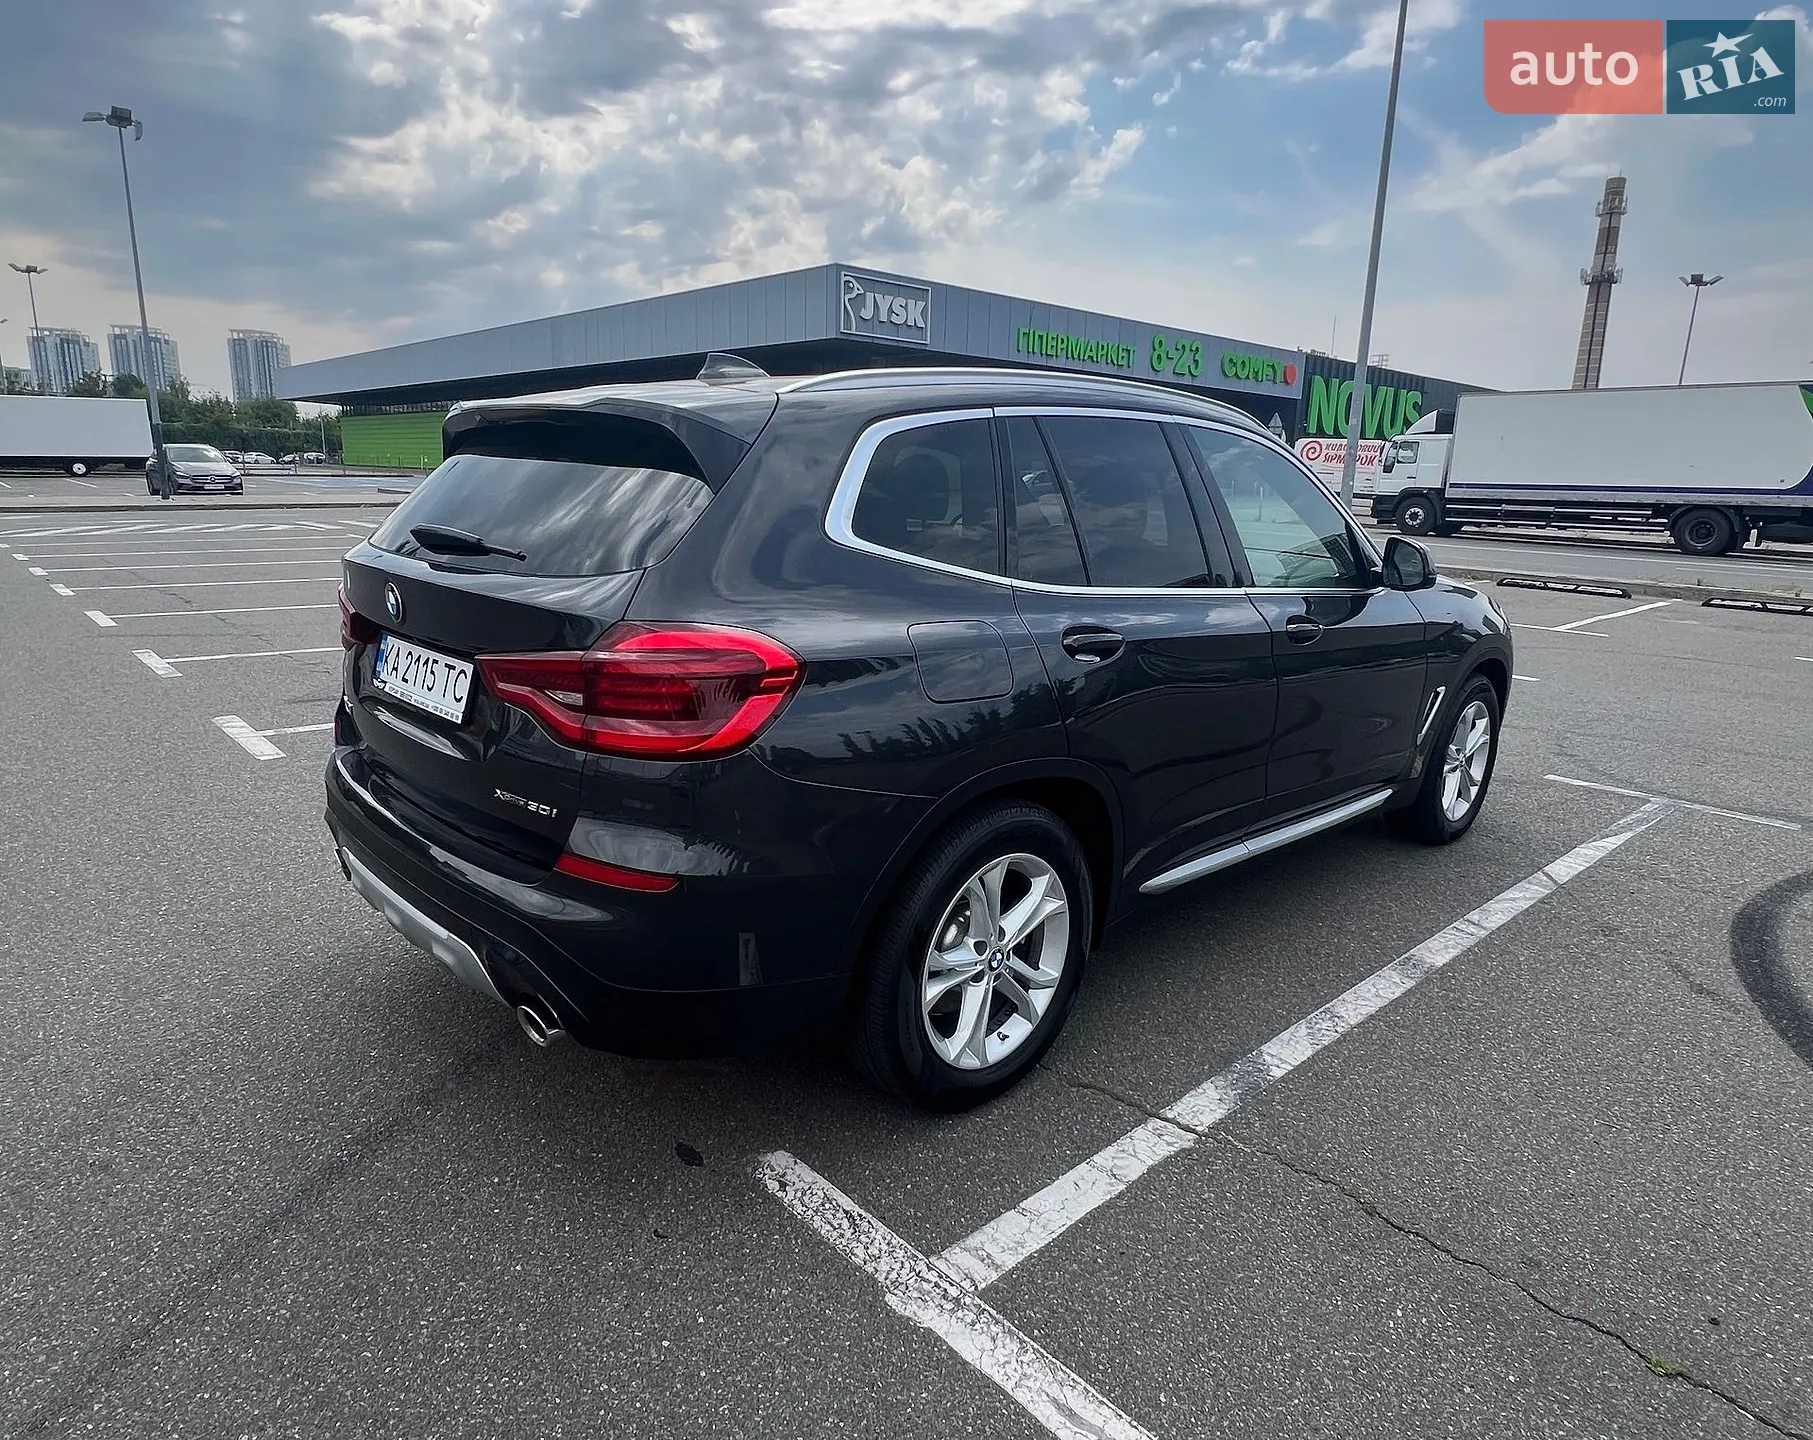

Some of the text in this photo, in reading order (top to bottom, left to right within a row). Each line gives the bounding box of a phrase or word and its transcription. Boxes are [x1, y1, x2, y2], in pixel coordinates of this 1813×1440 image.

[859, 291, 926, 328] JYSK
[1015, 327, 1201, 377] ГІПЕРМАРКЕТ 8-23
[1322, 452, 1378, 467] ЯРМРОК
[383, 642, 401, 680] KA
[401, 650, 439, 692] 2115
[442, 662, 468, 704] TC
